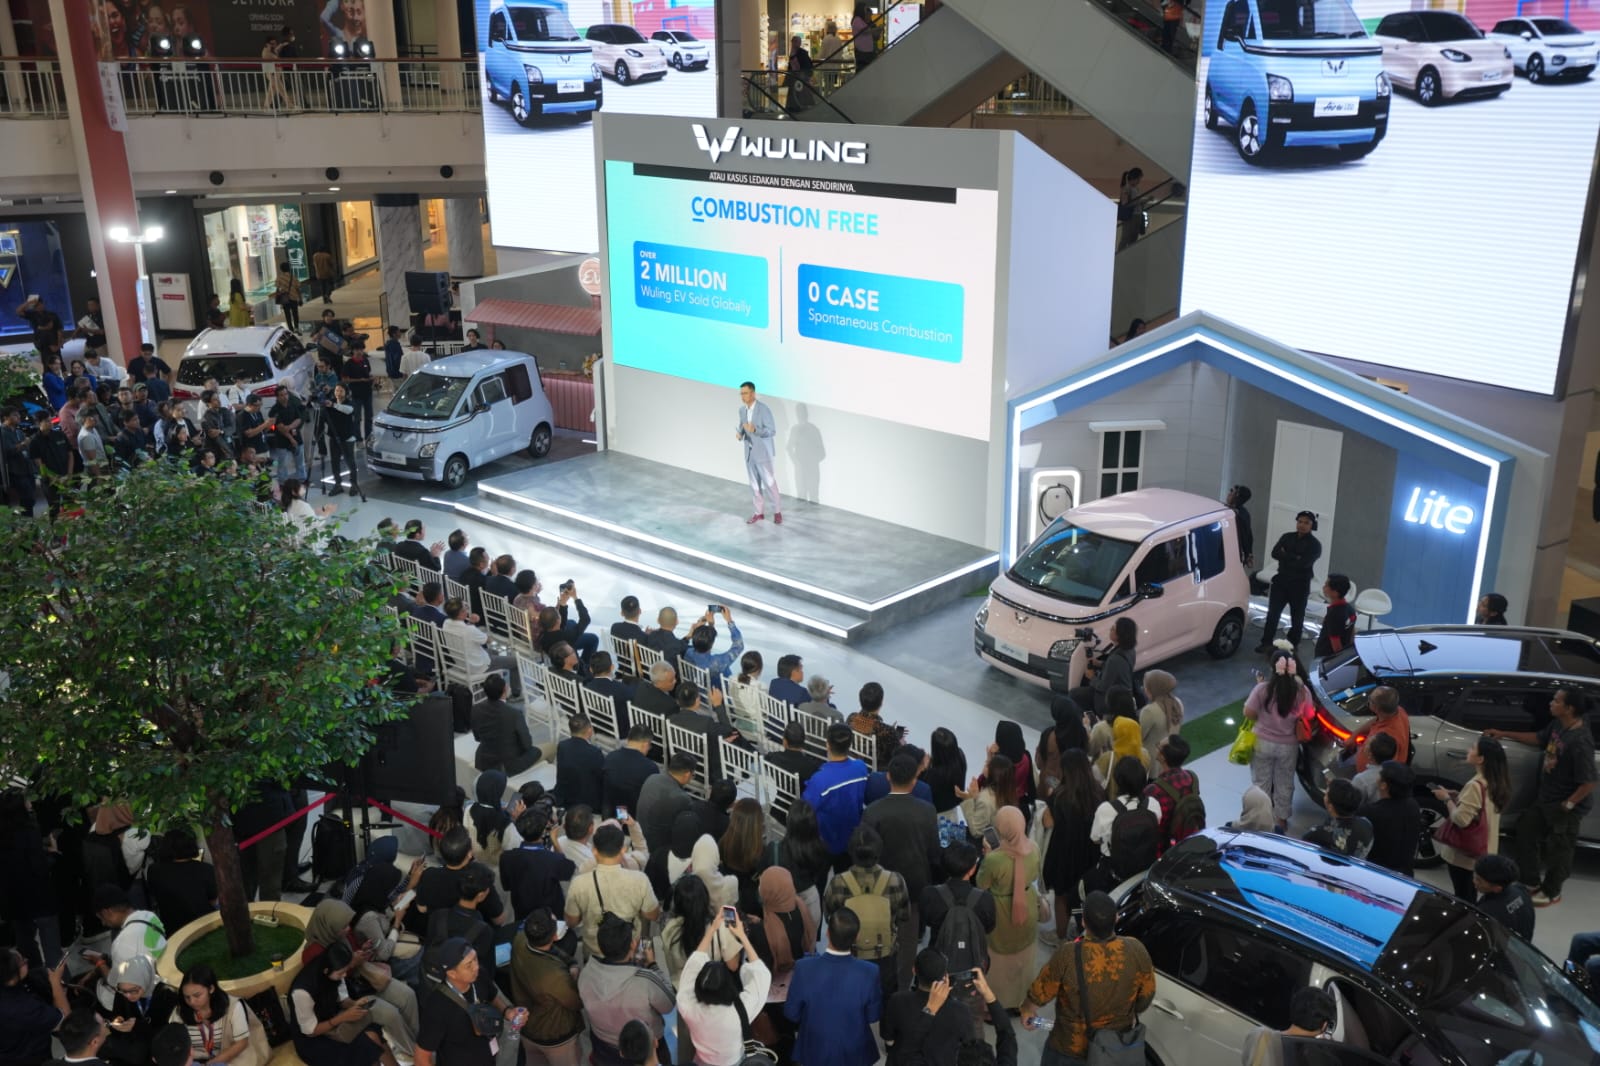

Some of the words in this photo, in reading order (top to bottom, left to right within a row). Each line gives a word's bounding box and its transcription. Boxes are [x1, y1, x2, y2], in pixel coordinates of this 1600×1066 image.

[741, 136, 867, 164] WULING
[709, 172, 726, 182] ATAU
[727, 173, 748, 184] KASUS
[749, 175, 780, 187] LEDAKAN
[780, 178, 811, 190] DENGAN
[812, 180, 856, 193] SENDIRINYA.
[691, 196, 820, 229] COMBUSTION
[828, 210, 879, 236] FREE
[640, 250, 656, 259] OVER
[641, 261, 651, 280] 2
[655, 263, 727, 291] MILLION
[640, 284, 672, 304] Wuling
[674, 289, 687, 303] EV
[688, 292, 710, 307] Sold
[711, 295, 752, 318] Globally
[808, 281, 820, 303] 0
[826, 284, 879, 312] CASE
[808, 308, 879, 332] Spontaneous
[881, 319, 953, 344] Combustion
[1404, 486, 1474, 534] Lite
